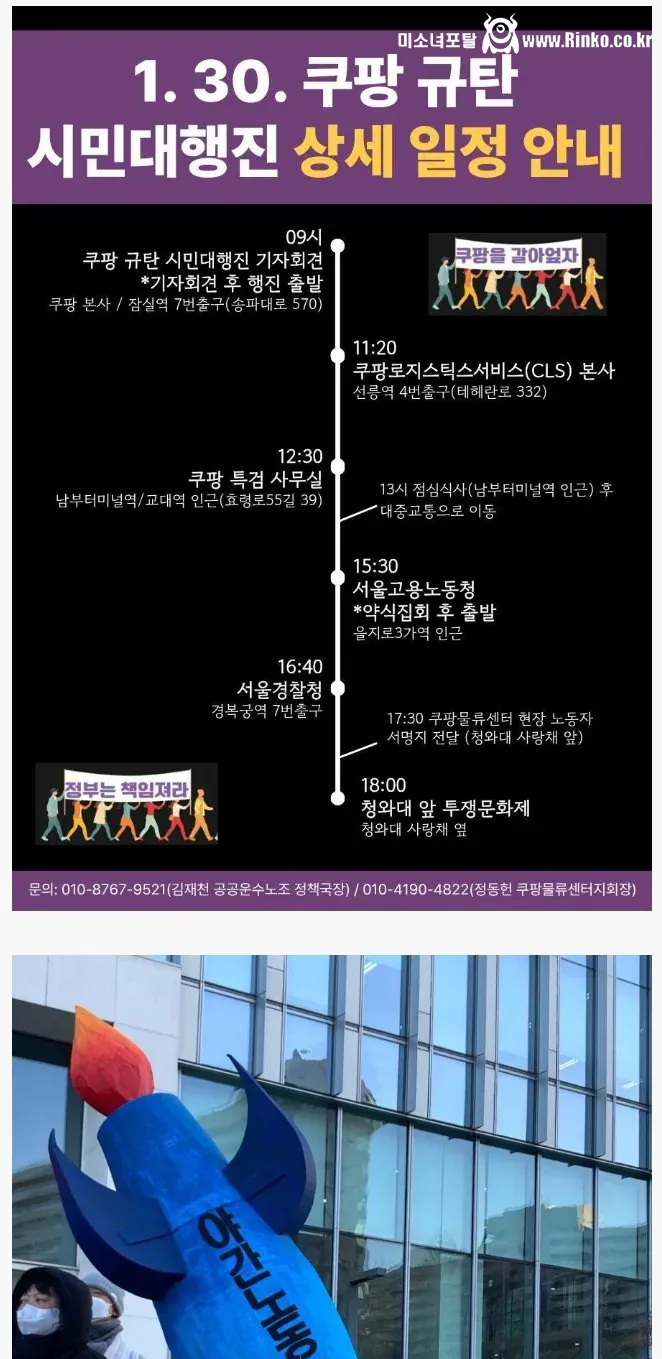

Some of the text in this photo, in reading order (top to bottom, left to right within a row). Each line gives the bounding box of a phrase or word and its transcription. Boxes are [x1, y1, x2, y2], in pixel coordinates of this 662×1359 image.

[135, 54, 518, 107] 1. 30. 쿠팡 규탄
[27, 124, 621, 178] 시민대행진 상세 일정 안내
[286, 229, 321, 246] 09시
[83, 252, 322, 270] 쿠팡 규탄 시민대행진 기자회견
[456, 247, 579, 264] 쿠팡을 갈아엎자
[224, 275, 241, 292] 후
[248, 275, 280, 293] 행진
[288, 274, 323, 293] 출발
[49, 297, 322, 312] 쿠팡 본사 / 잠실역 7번출구(송파대로 570)
[354, 341, 396, 355] 11:20
[353, 362, 615, 381] 쿠팡로지스틱스서비스(CLS) 본사
[354, 385, 546, 400] 선릉역 4번출구(테헤란로 332)
[279, 449, 322, 463] 12:30
[189, 471, 322, 489] 쿠팡 특검 사무실
[381, 483, 613, 497] 13시 점심식사(남부터미널역 인근) 후
[57, 494, 322, 508] 남부터미널역/교대역 인근(효령로55길 39)
[381, 504, 496, 519] 대중교통으로 이동
[354, 559, 398, 573] 15:30
[353, 580, 474, 599] 서울고용노동청
[437, 604, 454, 621] 후
[461, 603, 496, 622] 출발
[354, 627, 462, 641] 을지로3가역 인근
[279, 659, 322, 674] 16:40
[237, 681, 321, 700] 서울경찰청
[212, 704, 322, 719] 경복궁역 7번출구
[388, 712, 593, 726] 17:30 쿠팡물류센터 현장 노동자
[388, 730, 582, 745] 서명지 전달 (청와대 사랑채 앞)
[65, 781, 189, 799] 정부는 책임져라
[362, 778, 406, 792] 18:00
[362, 800, 529, 818] 청와대 앞 투쟁문화제
[362, 822, 466, 837] 청와대 사랑채 옆
[30, 883, 635, 897] 문의: 010-8767-9521(김재천 공공운수노조 정책국장) / 010-4190-4822(정동헌 쿠팡물류센터지회장)
